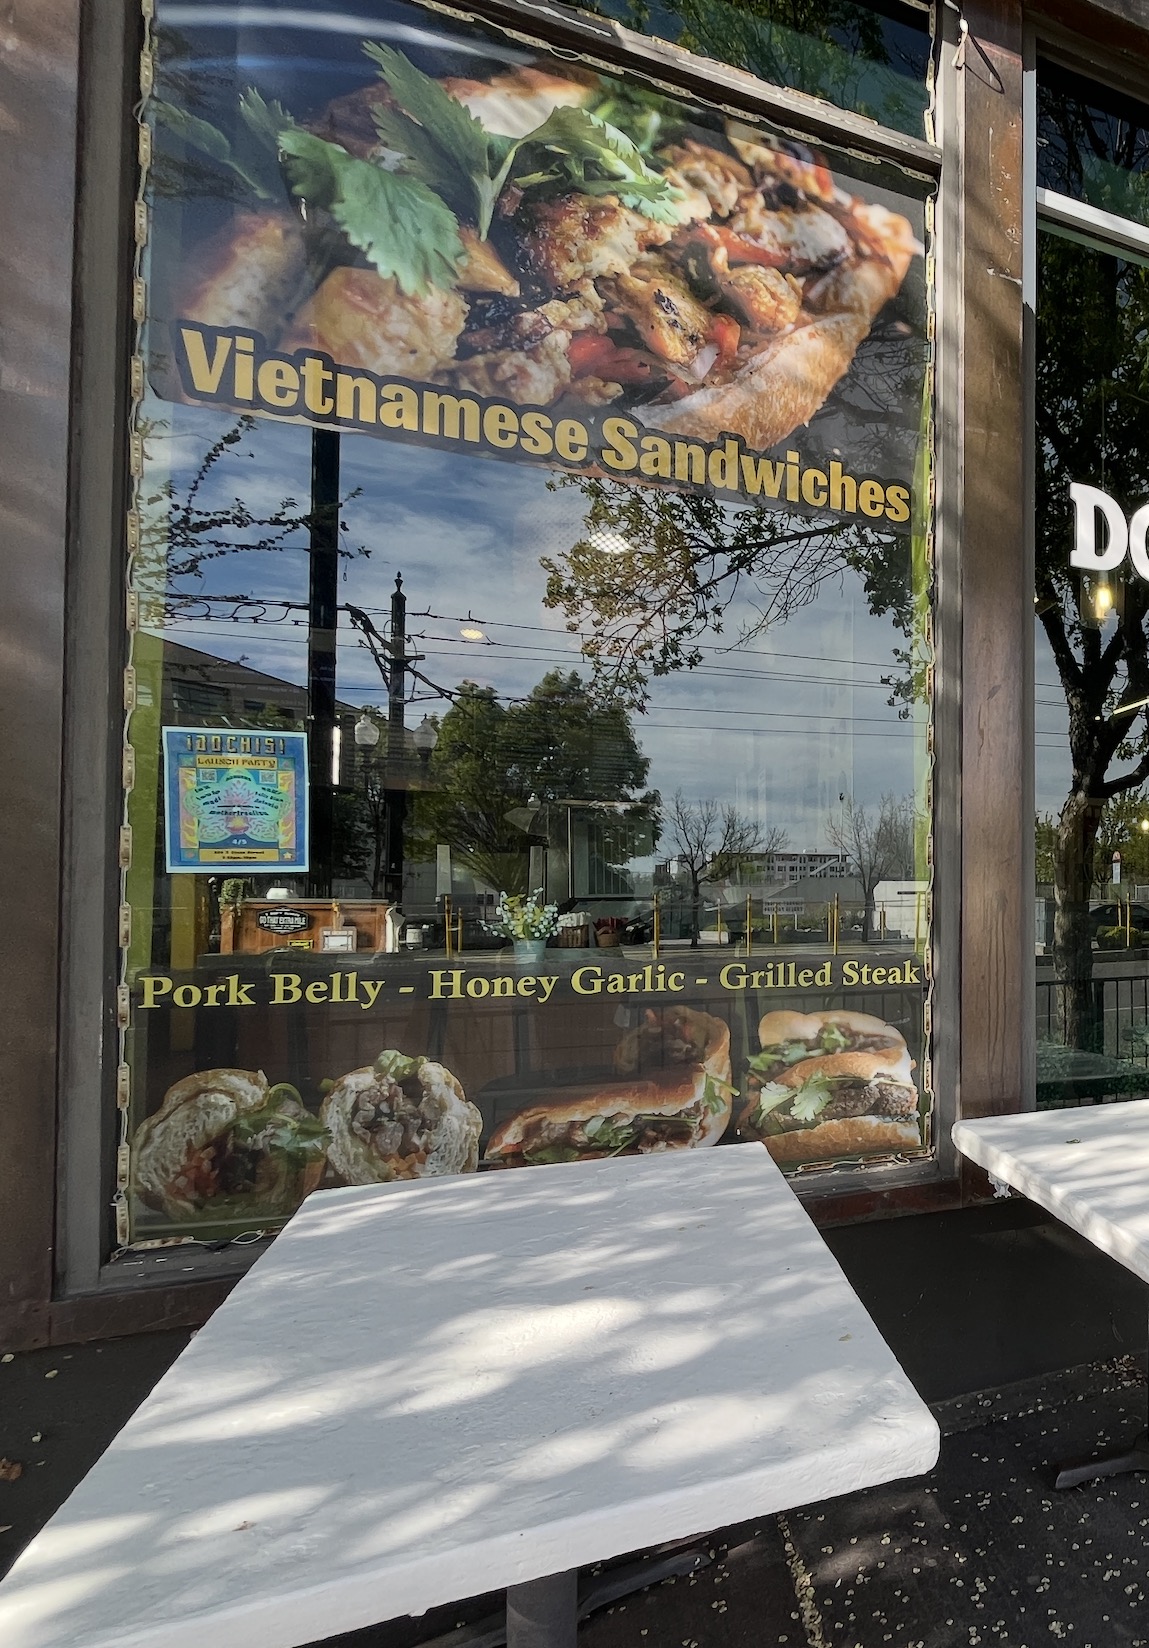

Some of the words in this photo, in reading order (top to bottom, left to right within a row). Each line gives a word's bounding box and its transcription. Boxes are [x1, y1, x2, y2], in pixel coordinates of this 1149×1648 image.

[180, 327, 589, 462] Vietnamese
[601, 417, 911, 523] Sandwiches
[241, 759, 276, 768] PARTY
[138, 973, 256, 1009] Pork
[269, 971, 385, 1010] Belly
[427, 969, 559, 1004] Honey
[571, 964, 685, 995] Garlic
[696, 977, 708, 985] -
[719, 961, 833, 991] Grilled
[841, 959, 921, 986] Steak
